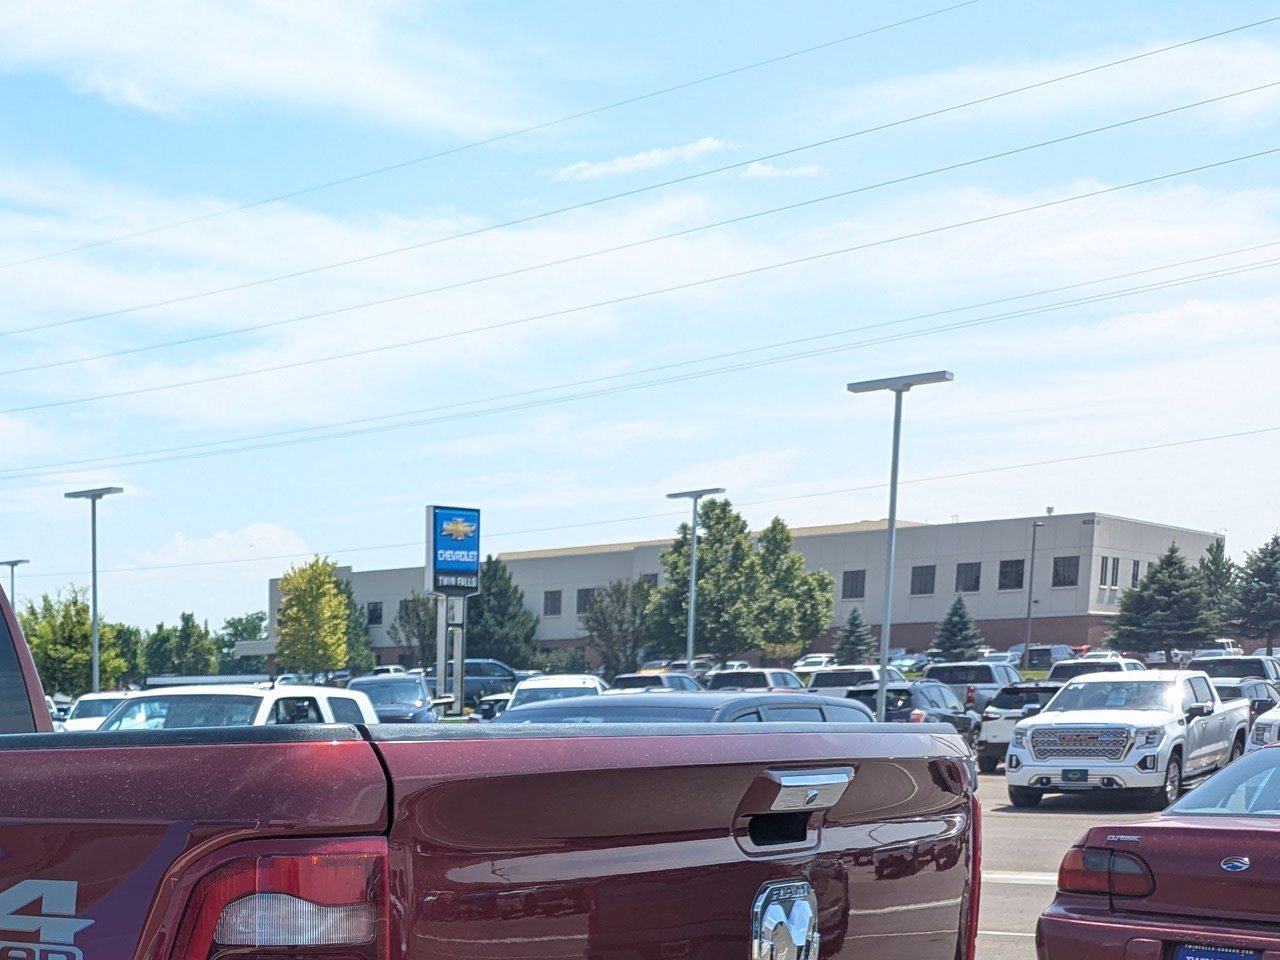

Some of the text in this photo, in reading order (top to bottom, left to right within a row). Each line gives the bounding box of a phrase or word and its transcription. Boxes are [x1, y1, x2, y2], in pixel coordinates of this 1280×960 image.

[438, 550, 477, 561] CHEVROLET
[438, 577, 476, 587] TWIN FALLS
[1058, 735, 1099, 743] GMC
[771, 883, 811, 900] RAM
